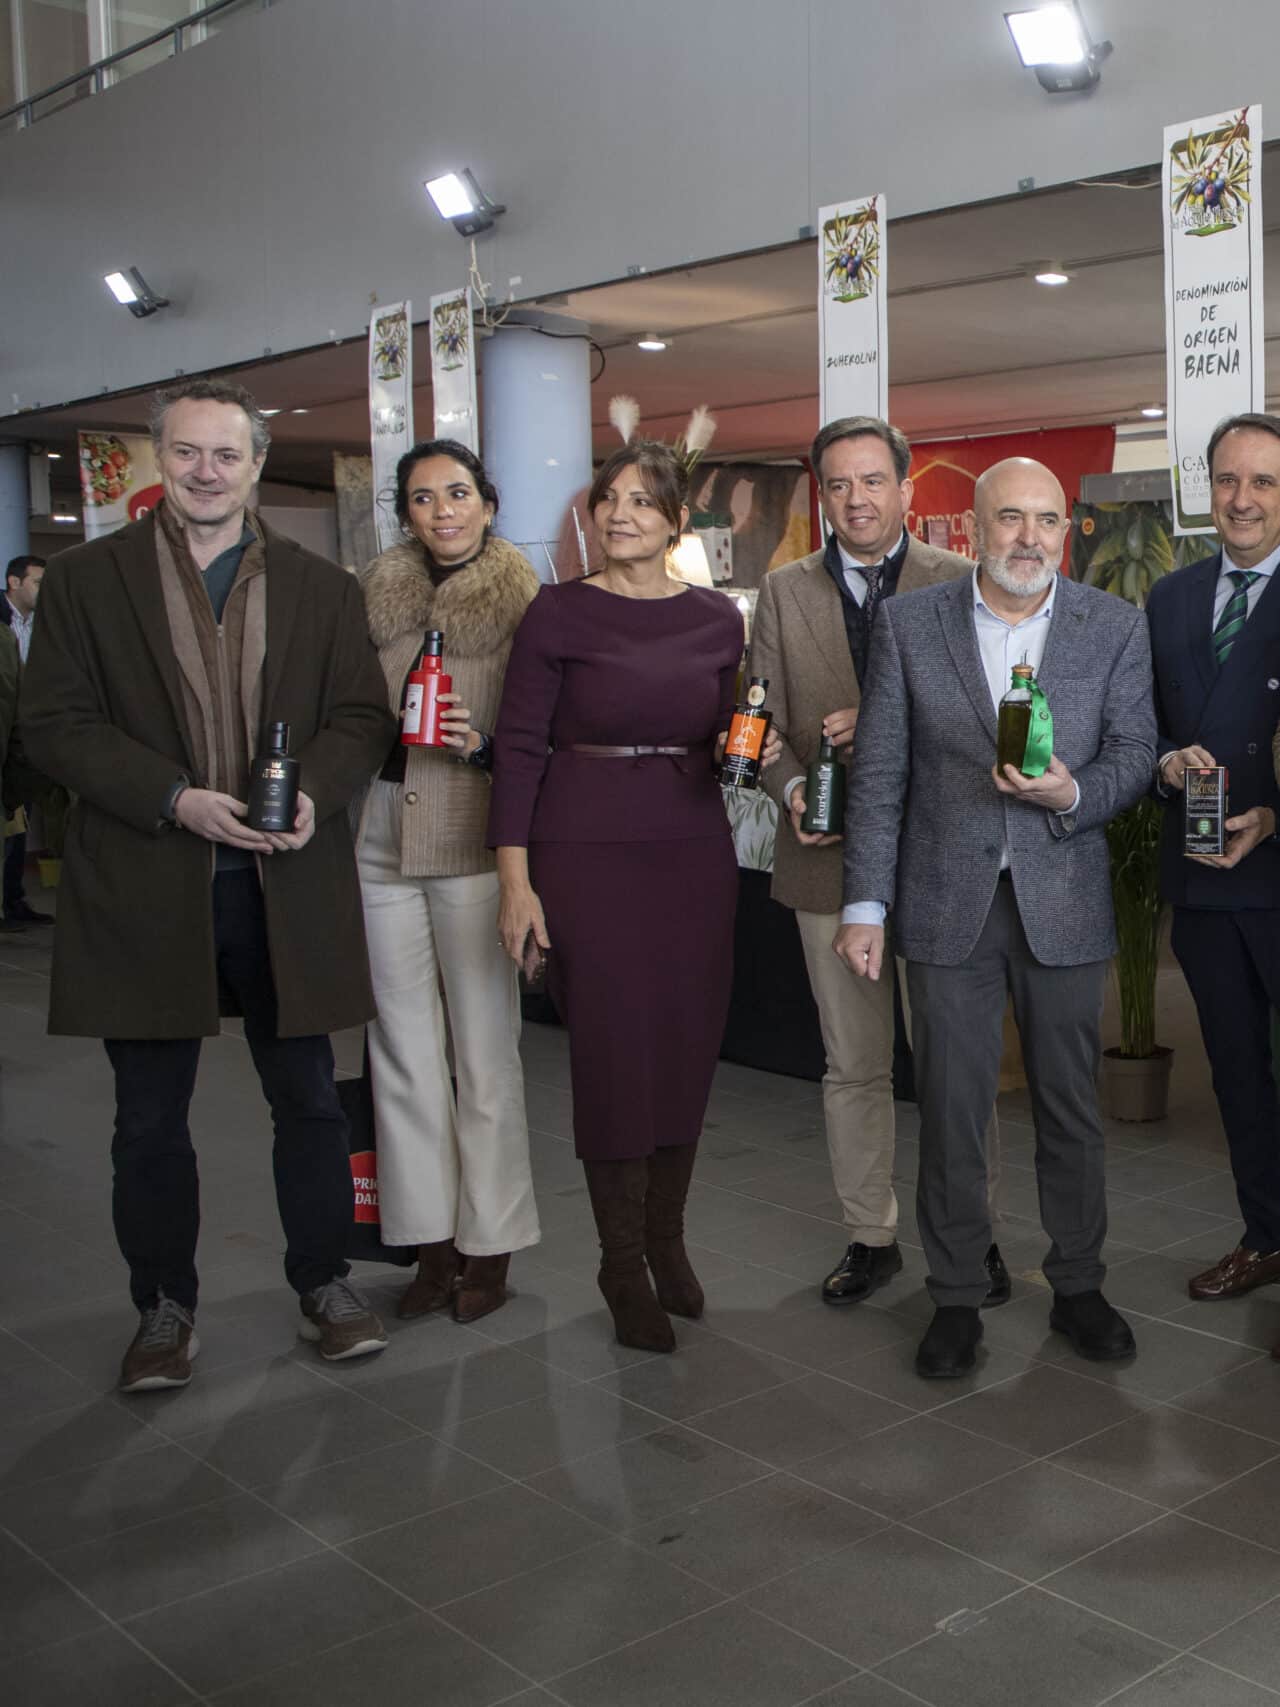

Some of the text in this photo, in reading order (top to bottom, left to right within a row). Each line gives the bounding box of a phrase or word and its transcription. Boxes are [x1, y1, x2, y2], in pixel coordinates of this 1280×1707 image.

[1176, 276, 1249, 302] DENOMINACIÓN
[1200, 304, 1218, 322] DE
[1184, 325, 1239, 349] ORIGEN
[1184, 350, 1241, 378] BAENA
